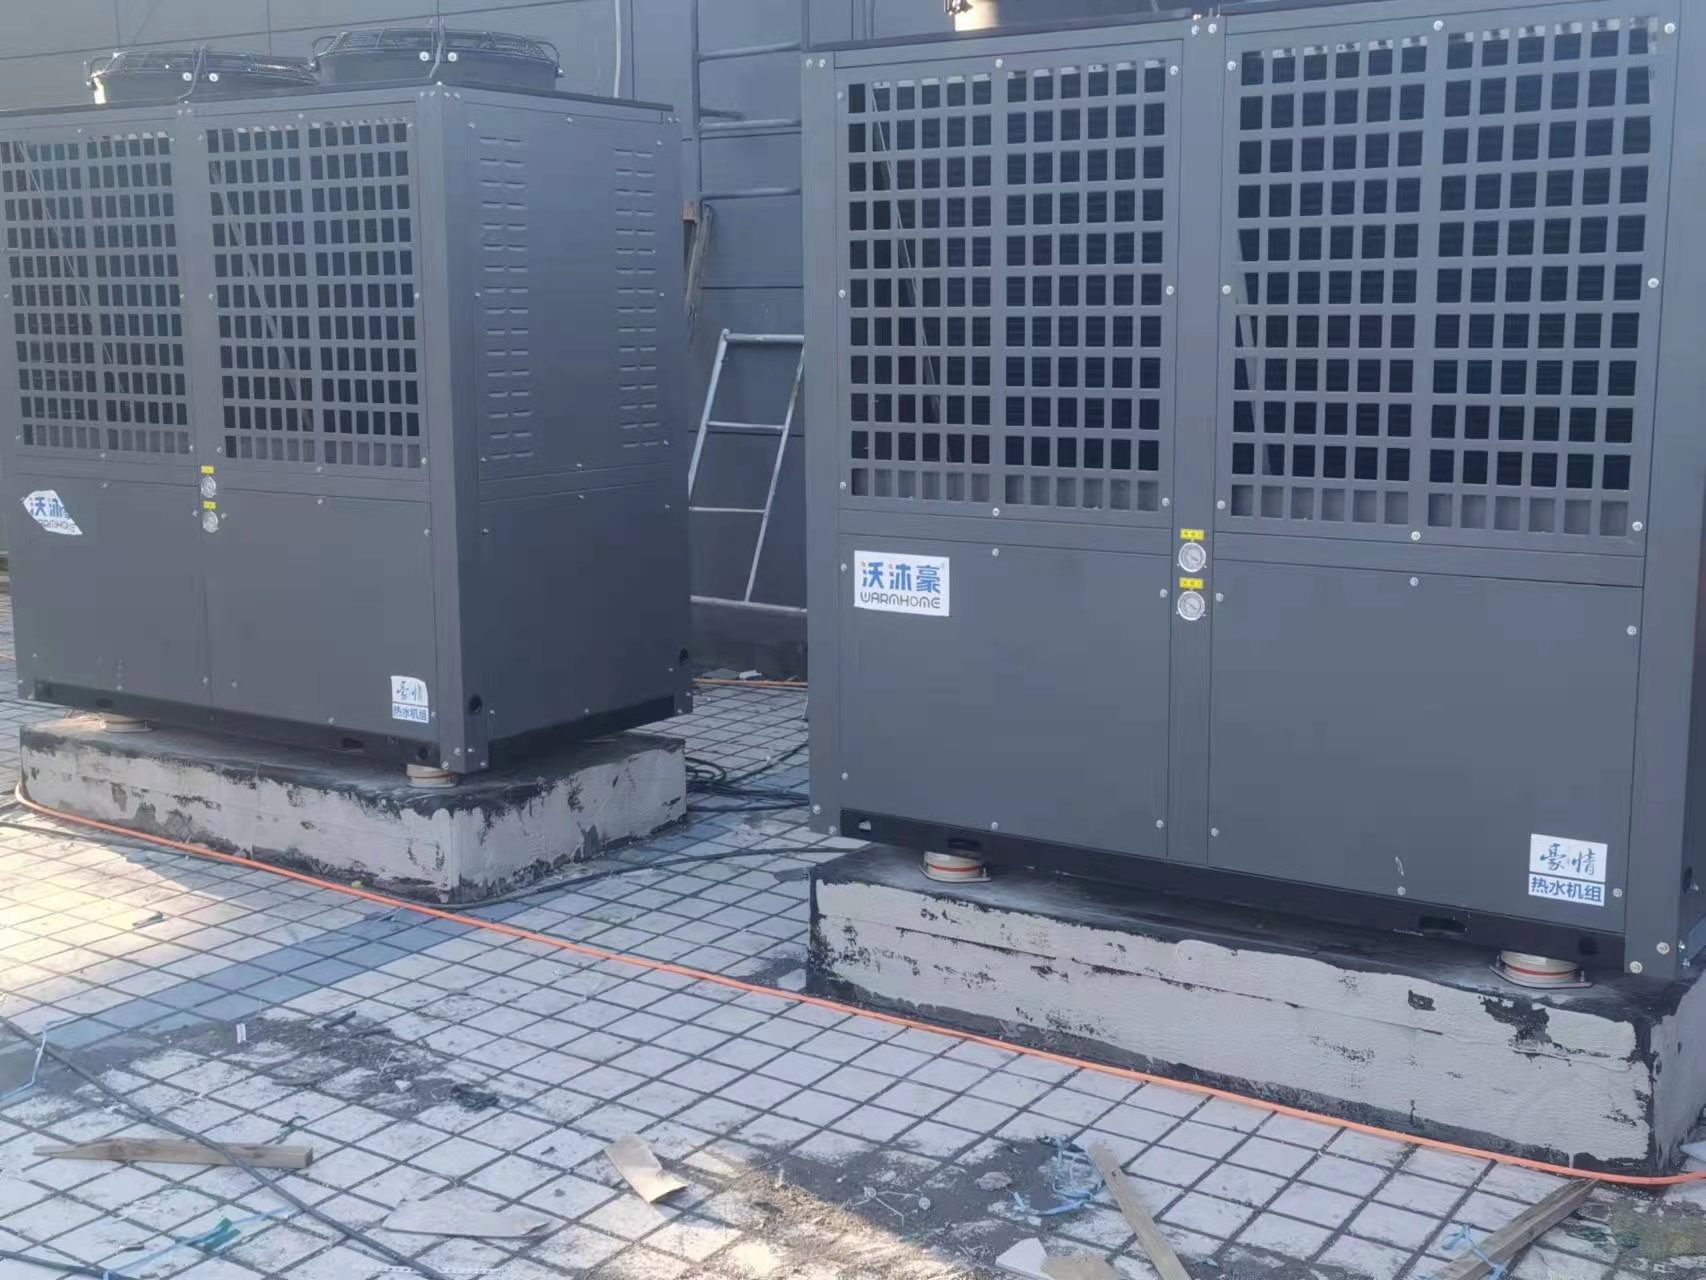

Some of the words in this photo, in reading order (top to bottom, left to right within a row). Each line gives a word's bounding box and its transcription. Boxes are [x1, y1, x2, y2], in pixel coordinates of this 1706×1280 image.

[861, 561, 941, 594] 沃沐豪
[860, 591, 941, 609] WARMHOME
[1539, 842, 1597, 876] 豪情
[1531, 876, 1602, 903] 热水机组
